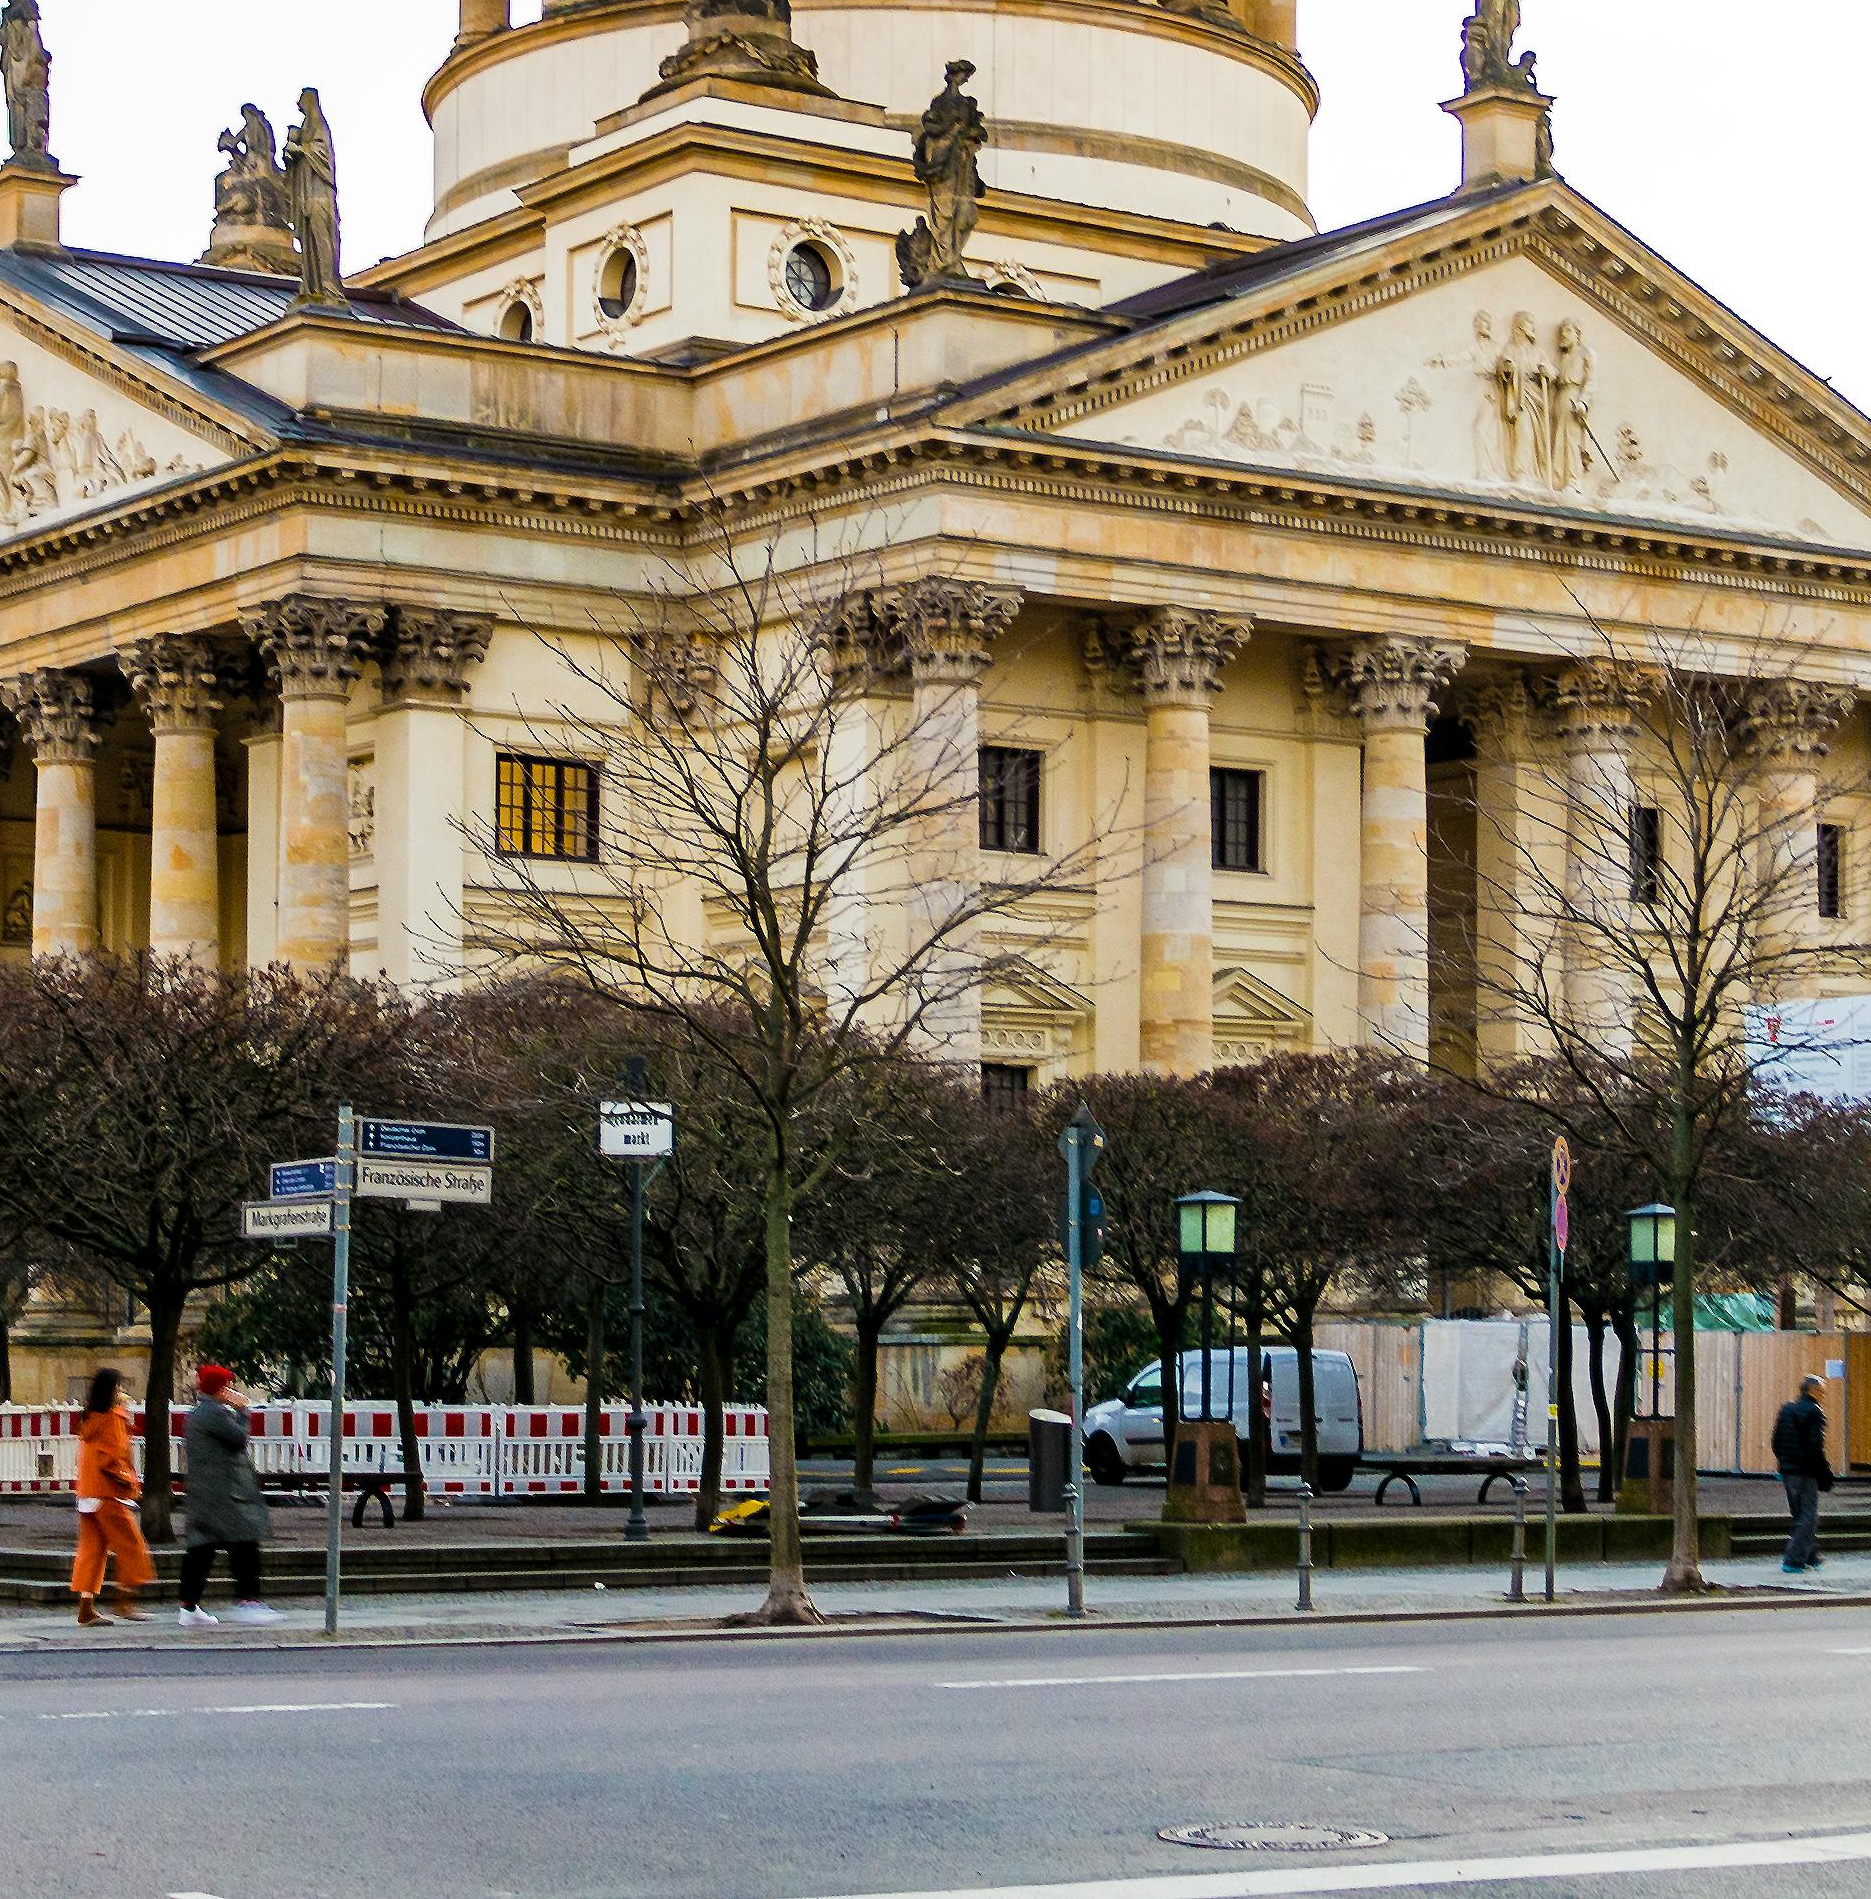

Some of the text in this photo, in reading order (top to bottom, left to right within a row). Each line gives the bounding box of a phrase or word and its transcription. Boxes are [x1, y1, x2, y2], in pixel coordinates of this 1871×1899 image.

[362, 1166, 485, 1195] Französische Straße
[252, 1206, 327, 1230] Markgrafenstraße
